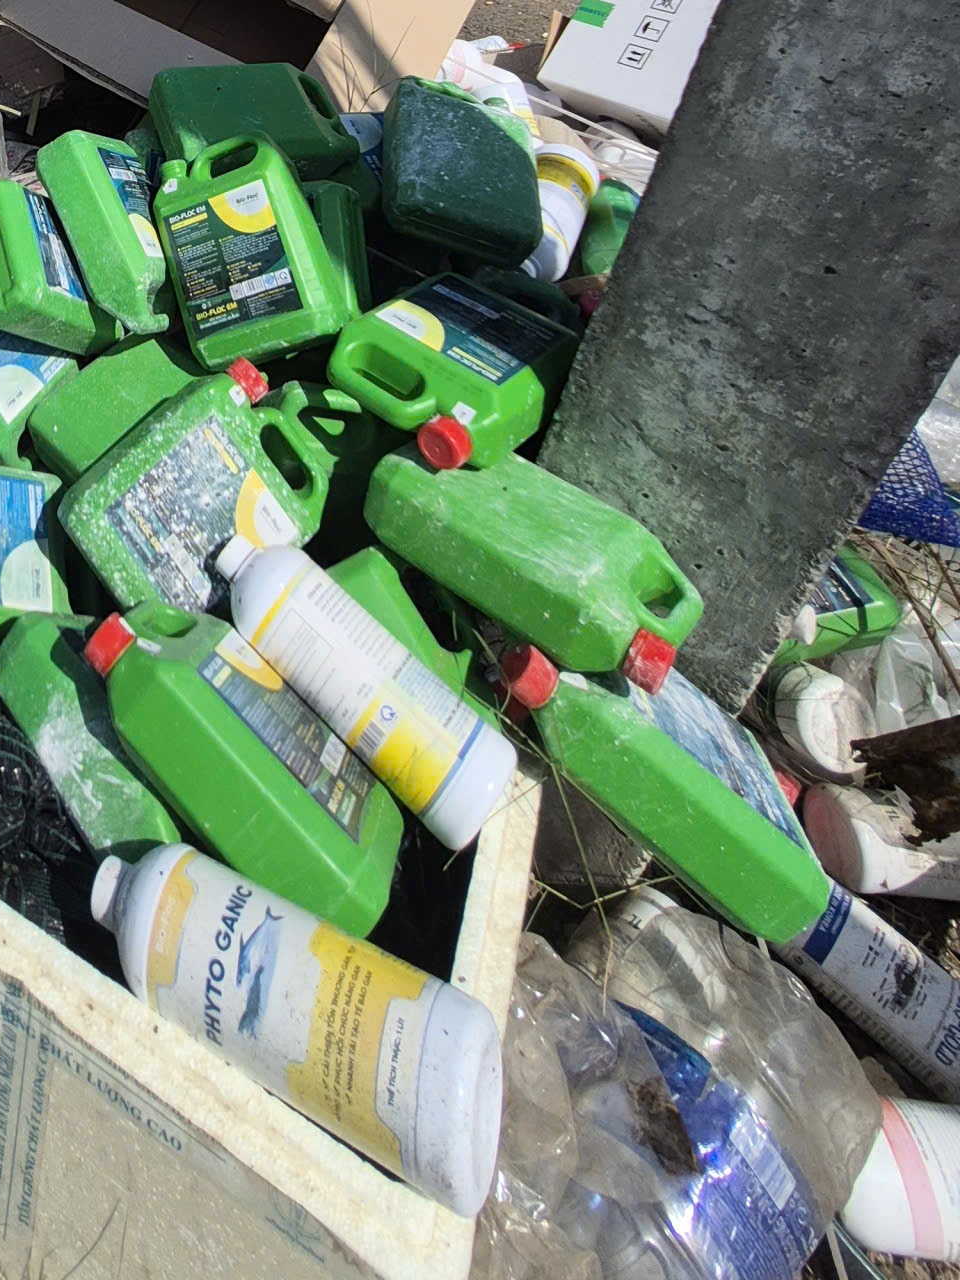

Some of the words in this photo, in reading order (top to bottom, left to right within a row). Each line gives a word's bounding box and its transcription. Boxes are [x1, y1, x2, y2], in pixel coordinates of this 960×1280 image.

[169, 208, 196, 223] BIO-FLOC
[196, 306, 227, 320] BIO-FLOC
[203, 958, 227, 1047] PHYTO
[215, 884, 253, 952] GANIC
[344, 1057, 355, 1090] NHANH
[87, 1071, 142, 1122] LƯỢNG
[147, 1118, 182, 1152] CAO
